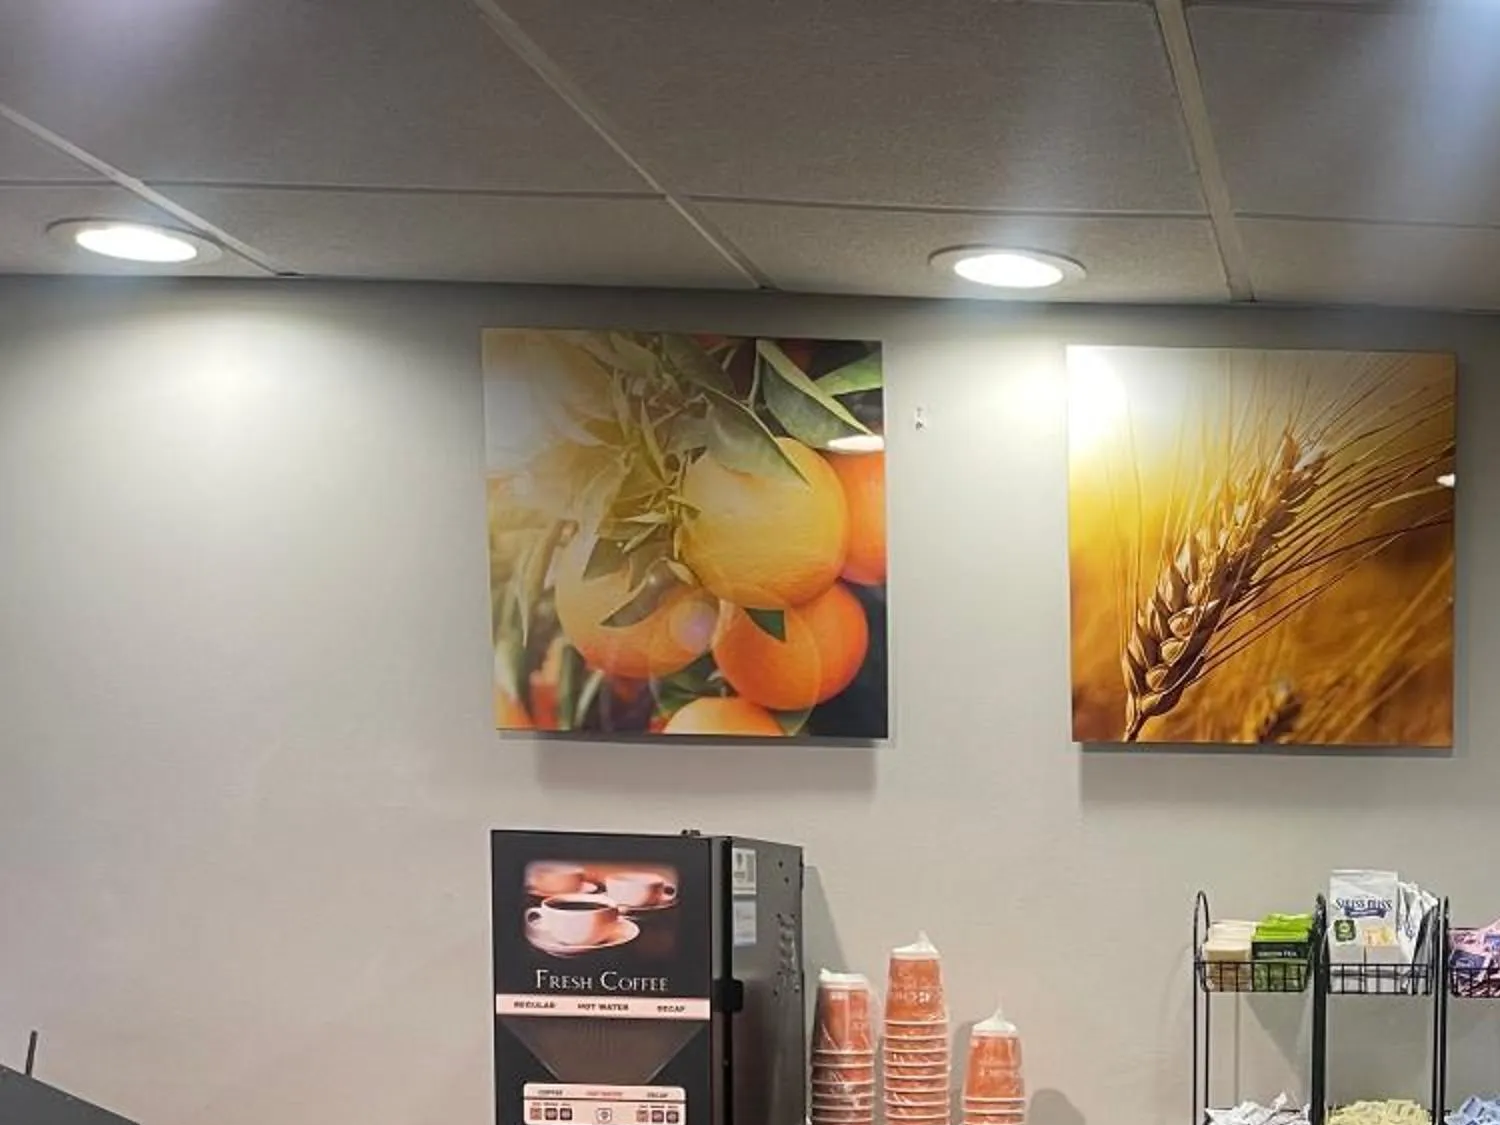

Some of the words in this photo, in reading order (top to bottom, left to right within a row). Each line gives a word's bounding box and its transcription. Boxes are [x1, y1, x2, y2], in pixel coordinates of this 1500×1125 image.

[535, 969, 593, 991] FRESH
[600, 971, 669, 993] COFFEE
[577, 1002, 596, 1011] HOT
[599, 1003, 630, 1012] WATER
